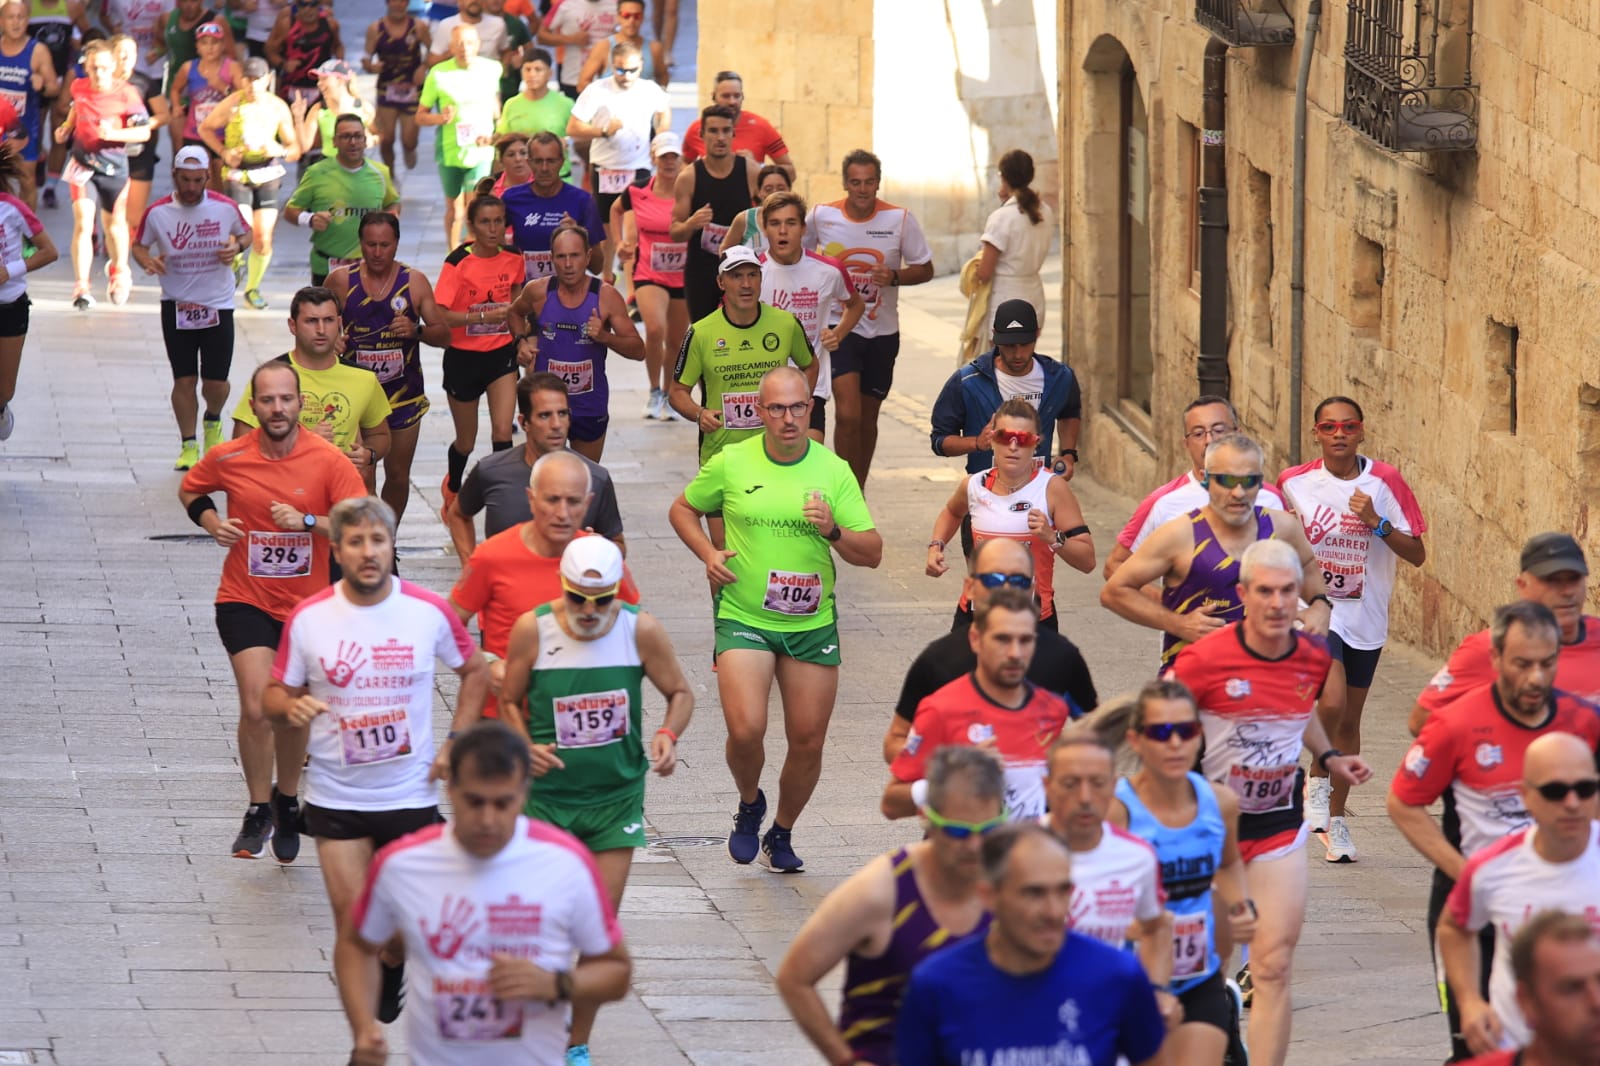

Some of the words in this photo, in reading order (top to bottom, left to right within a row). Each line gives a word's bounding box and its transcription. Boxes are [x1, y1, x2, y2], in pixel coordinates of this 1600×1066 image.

[660, 253, 682, 264] 197
[186, 308, 209, 321] 283
[562, 373, 580, 385] 45
[251, 534, 311, 547] bedunia
[262, 546, 298, 564] 296
[1322, 570, 1345, 589] 93
[781, 586, 812, 603] 104
[340, 710, 406, 731] bedunia
[573, 708, 614, 732] 159
[355, 724, 396, 749] 110
[1243, 779, 1282, 799] 180
[451, 995, 505, 1022] 241
